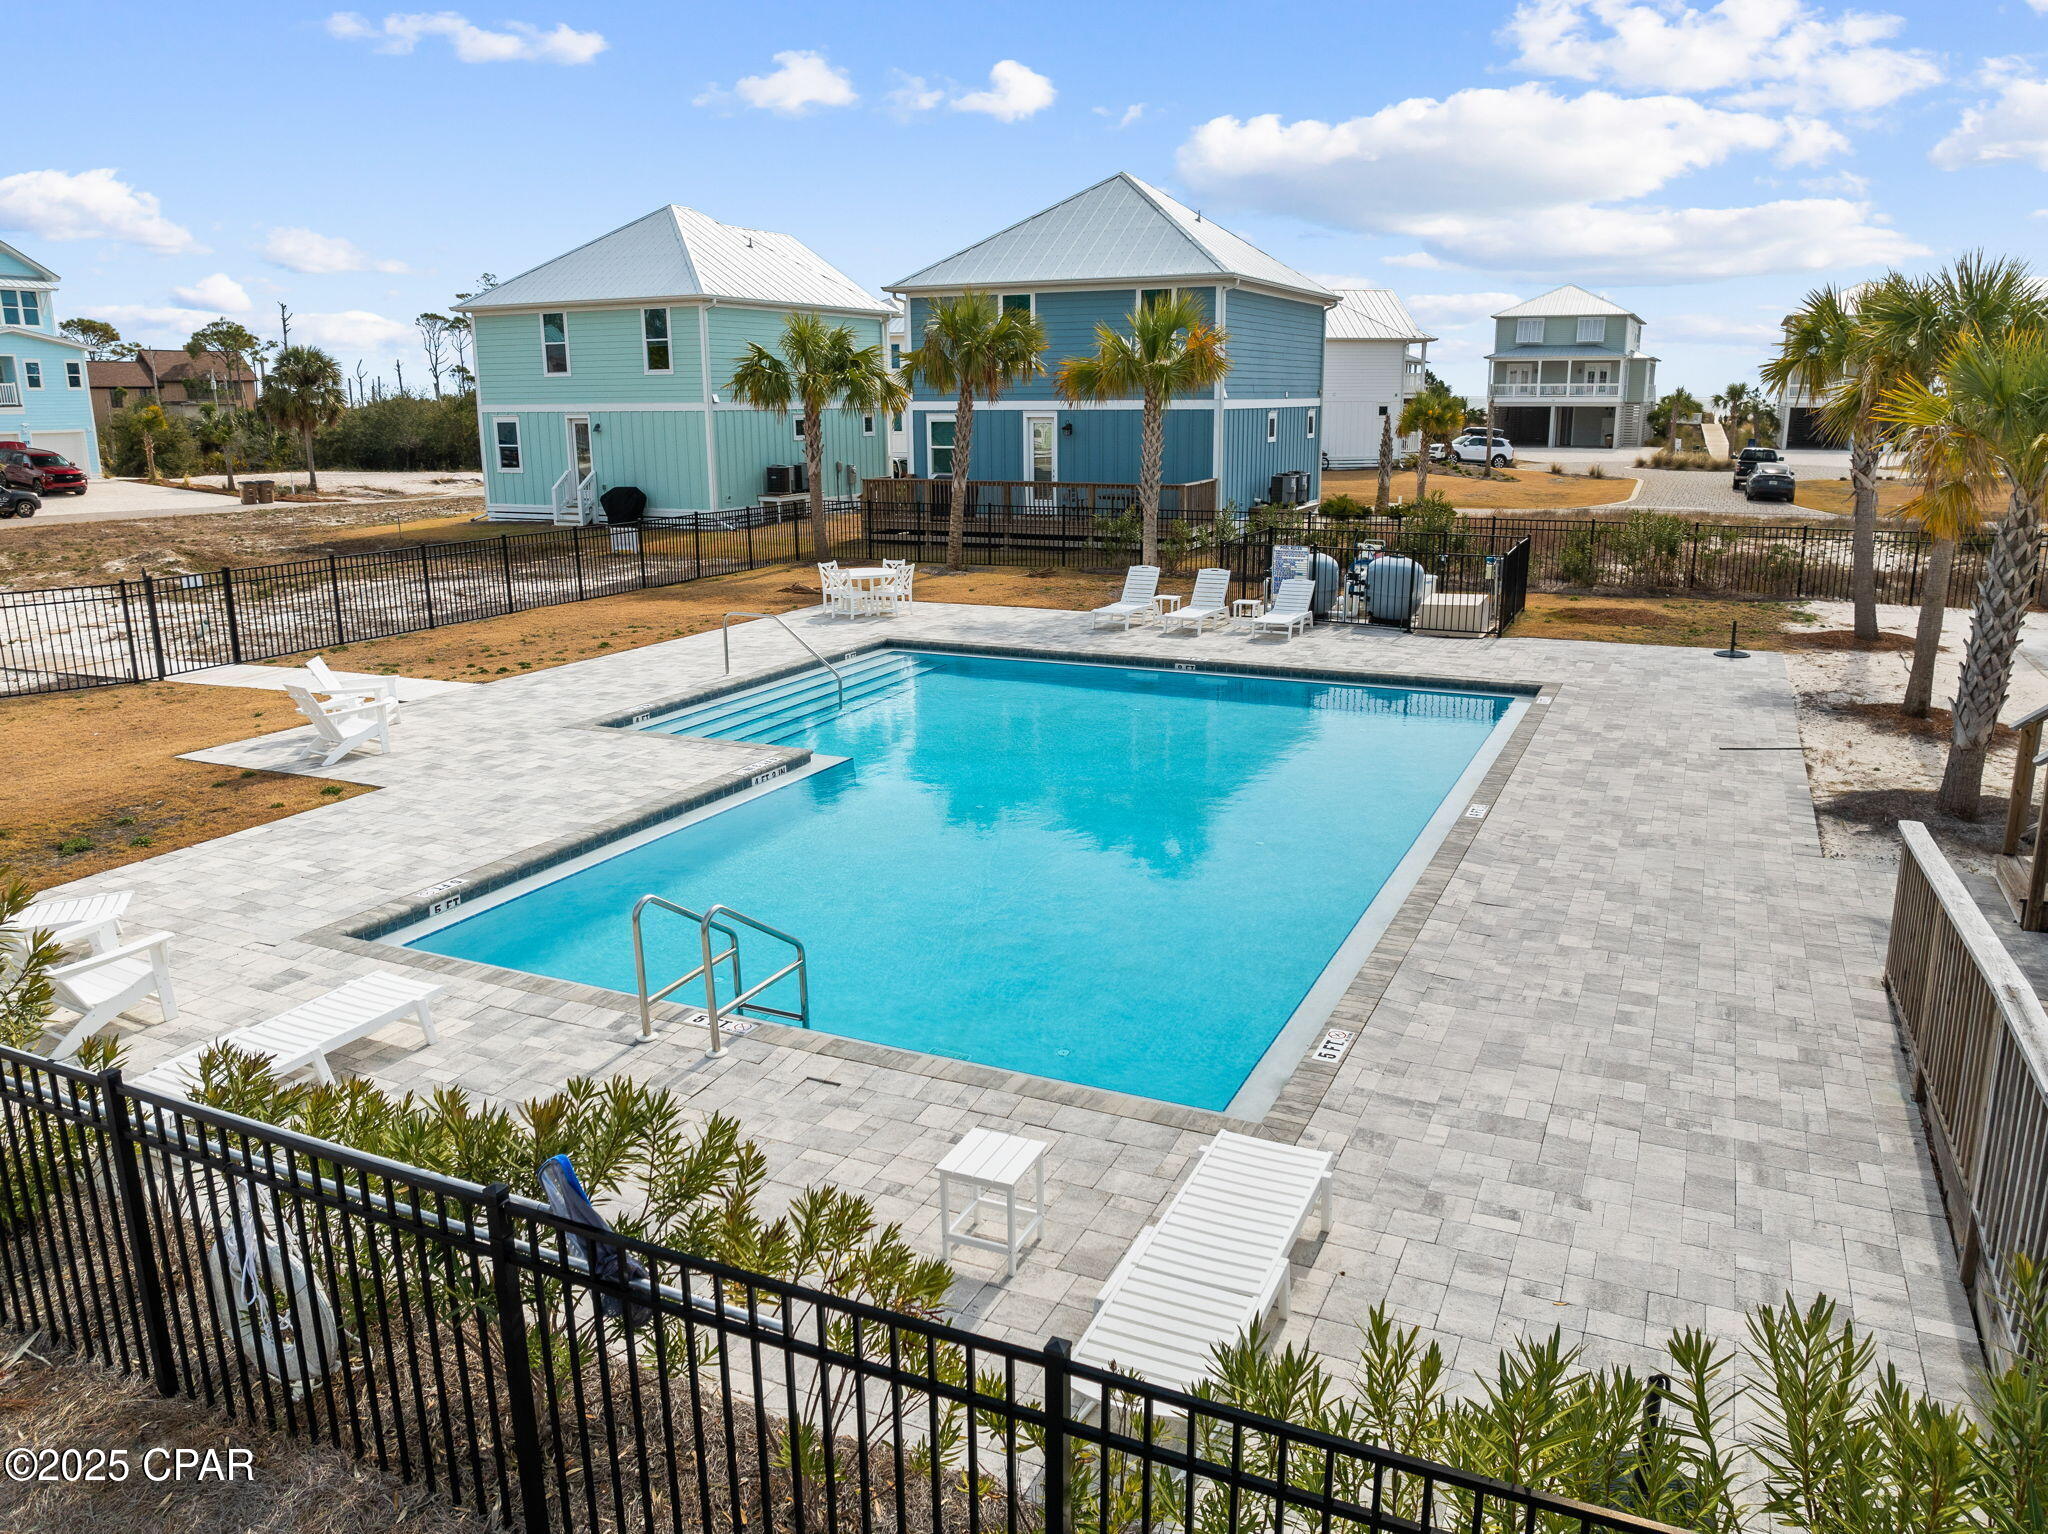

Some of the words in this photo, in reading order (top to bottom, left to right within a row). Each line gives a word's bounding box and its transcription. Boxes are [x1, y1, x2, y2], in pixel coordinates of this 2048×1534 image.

[761, 774, 769, 782] FT
[779, 768, 786, 776] IN
[435, 904, 441, 913] 5
[446, 897, 459, 909] FT
[693, 1015, 708, 1023] 5
